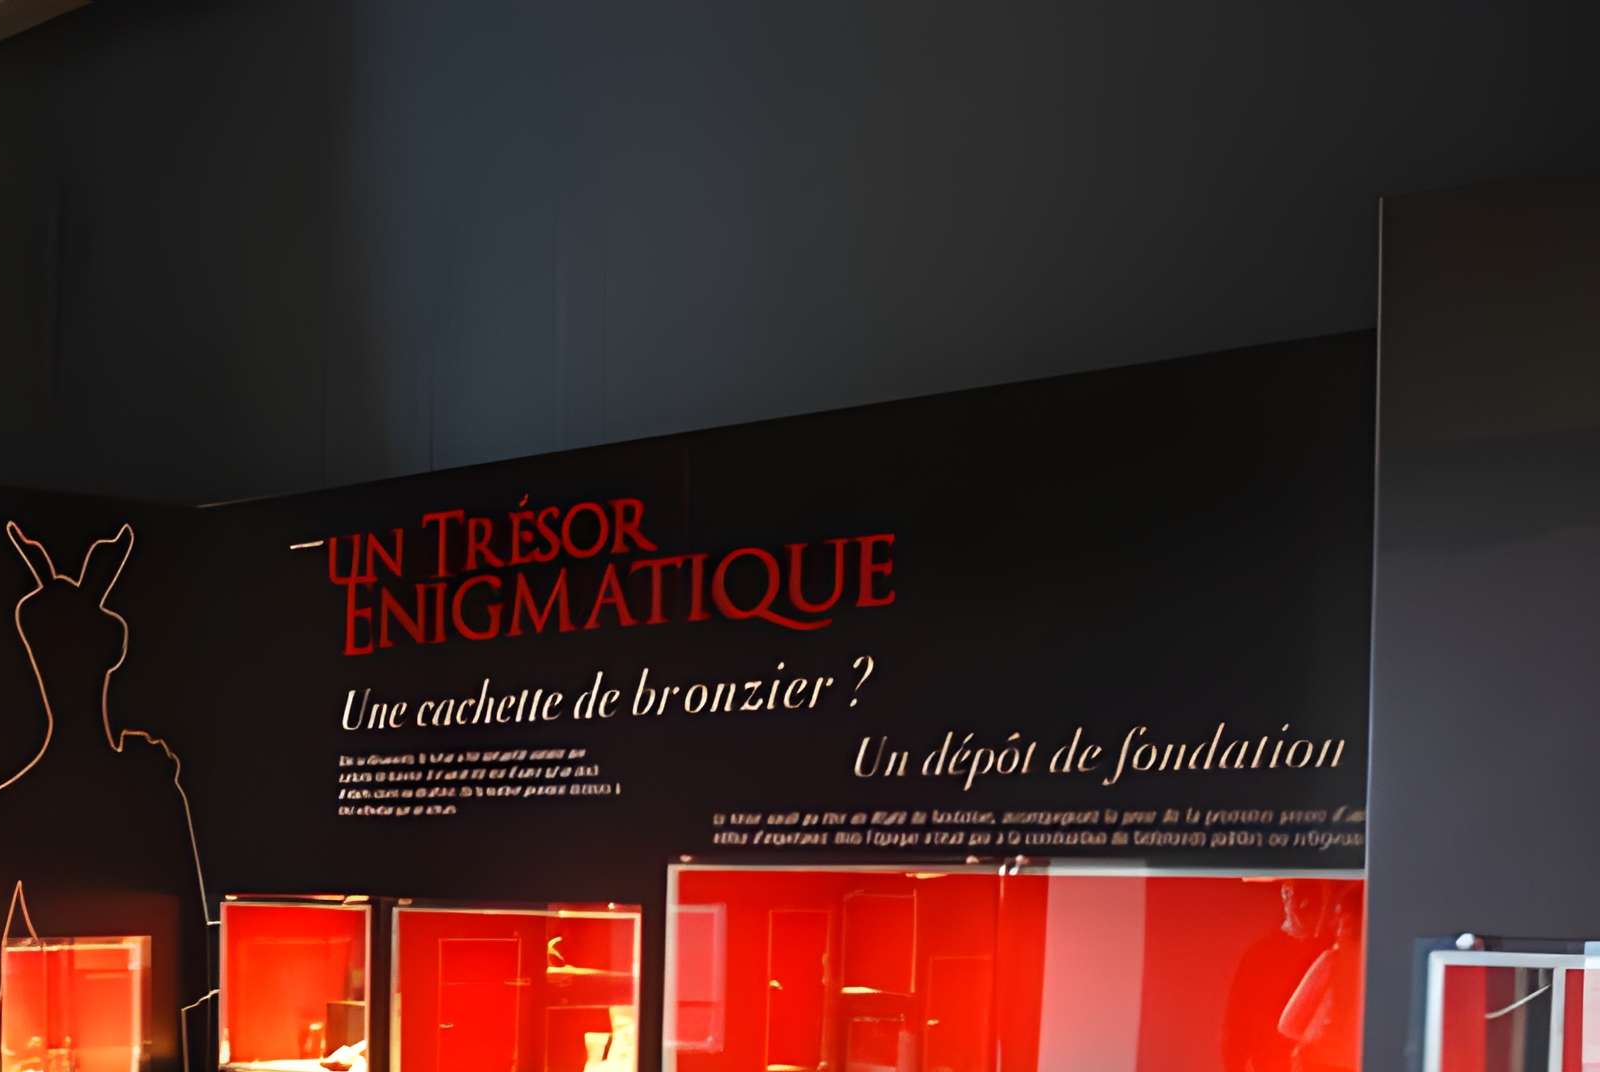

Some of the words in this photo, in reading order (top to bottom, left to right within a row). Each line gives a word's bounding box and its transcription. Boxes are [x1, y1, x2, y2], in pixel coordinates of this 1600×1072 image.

[327, 527, 403, 586] UN
[341, 688, 408, 731] Une
[416, 677, 564, 728] cachette
[573, 670, 621, 720] de
[632, 660, 835, 717] bronzier
[853, 735, 909, 778] Un
[921, 730, 1038, 791] dépôt
[1049, 726, 1103, 774] de
[1101, 721, 1346, 787] fondation
